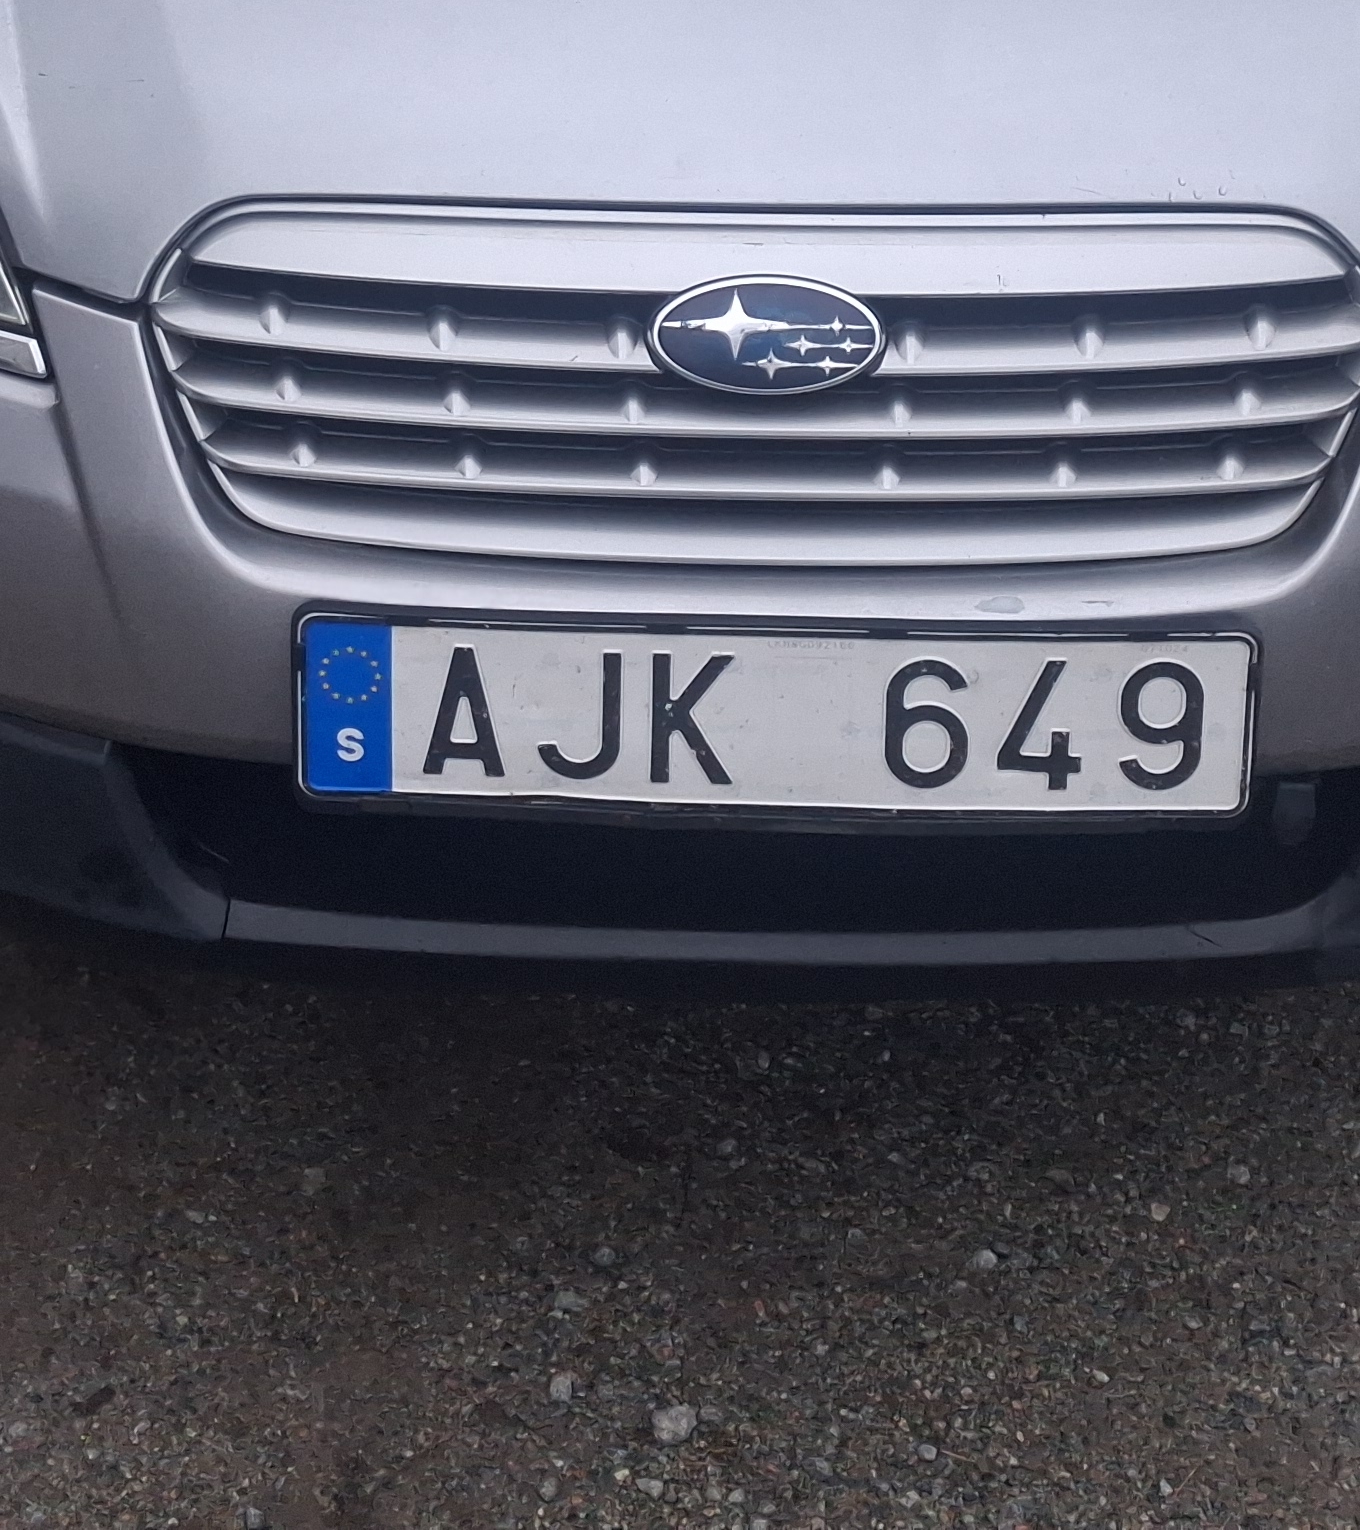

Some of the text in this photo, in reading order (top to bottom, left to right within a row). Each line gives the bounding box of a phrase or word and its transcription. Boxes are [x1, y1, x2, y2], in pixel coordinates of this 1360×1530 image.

[336, 727, 365, 762] S
[422, 646, 1205, 791] AJK 649
